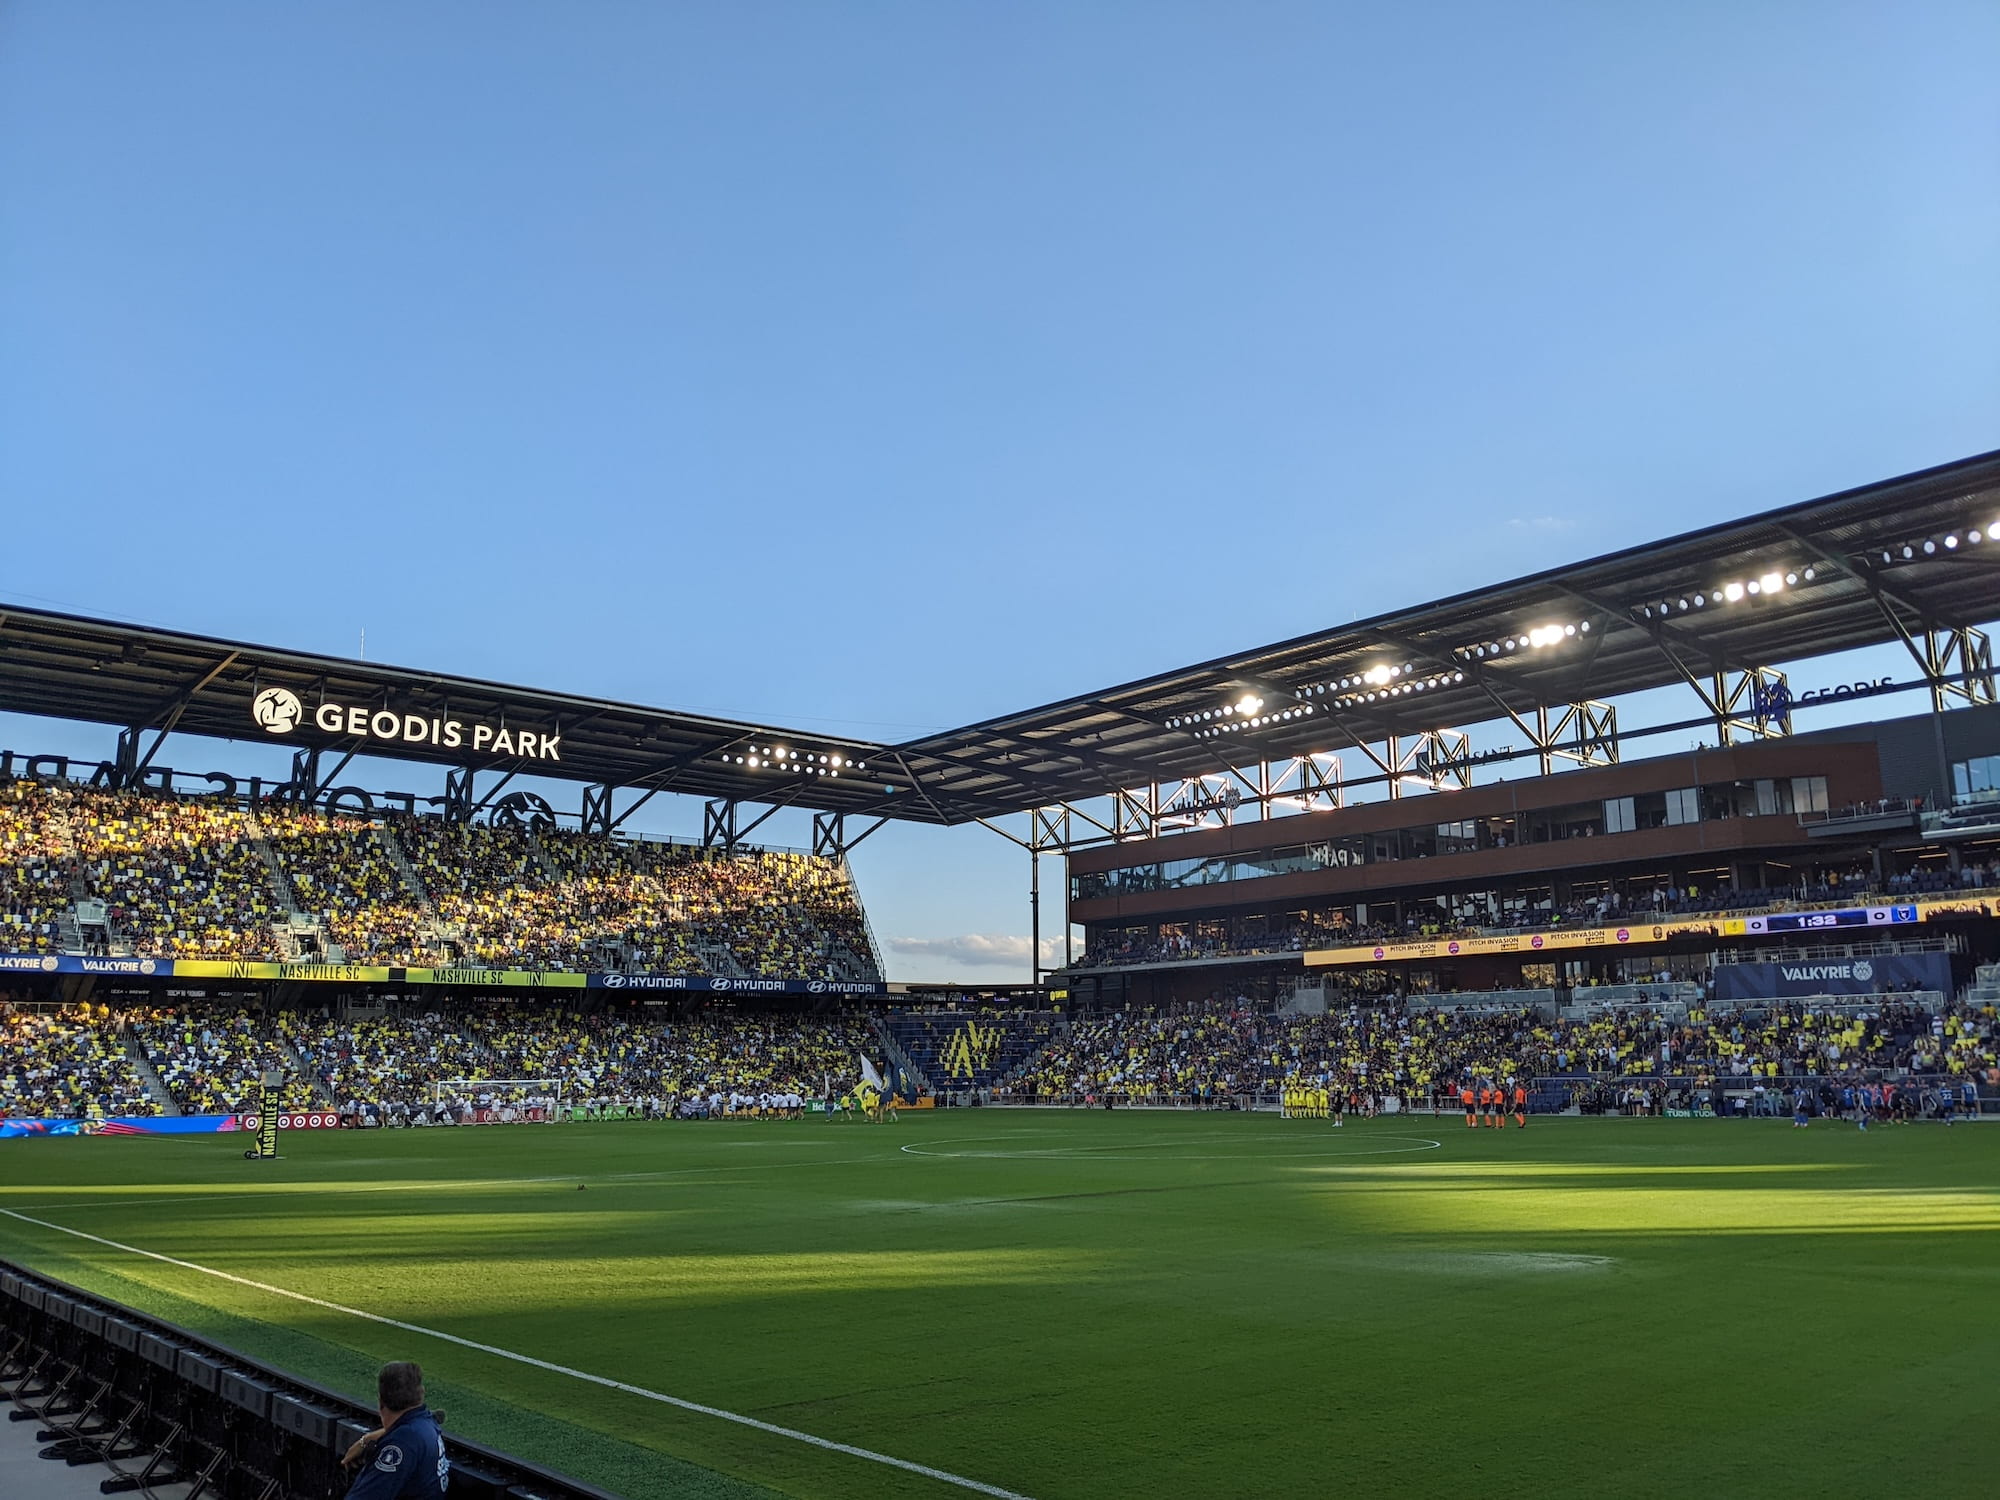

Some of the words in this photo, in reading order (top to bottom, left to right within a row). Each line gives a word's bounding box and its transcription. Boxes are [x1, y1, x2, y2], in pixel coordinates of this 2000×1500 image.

[315, 702, 462, 748] GEODIS
[472, 724, 561, 760] PARK
[1798, 915, 1837, 928] 1:32
[1487, 937, 1519, 945] INVASION
[1570, 930, 1605, 940] INVASION
[0, 957, 40, 970] LKYRIE
[82, 958, 139, 972] VALKYRIE
[279, 964, 342, 979] NASHVILLE
[345, 967, 360, 979] SC
[432, 969, 487, 984] NASHVILLE
[490, 972, 503, 984] SC
[1781, 965, 1850, 981] VALKYRIE
[629, 977, 686, 988] HYUNDAI
[733, 979, 785, 991] HYUNDAI
[828, 983, 875, 993] HYUNDAI
[262, 1105, 278, 1156] NASHVILLE
[270, 1091, 278, 1104] SC
